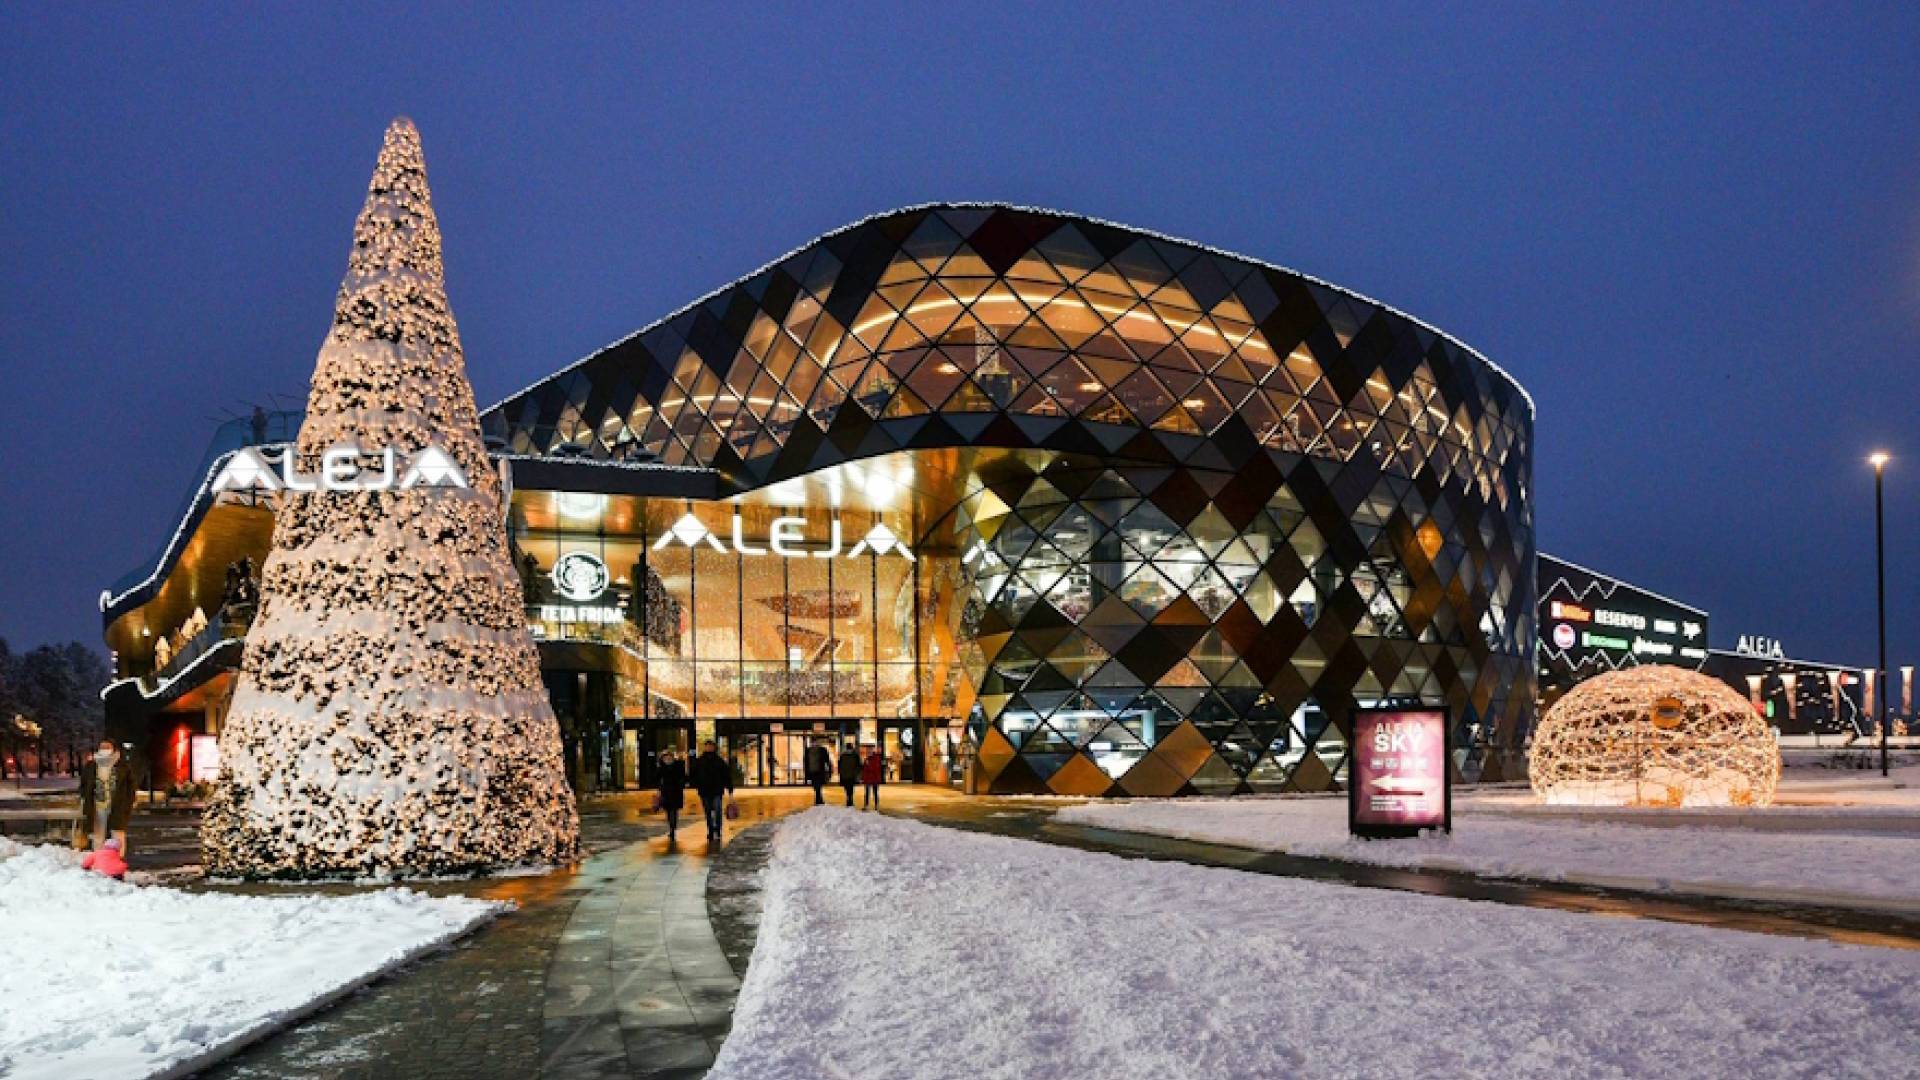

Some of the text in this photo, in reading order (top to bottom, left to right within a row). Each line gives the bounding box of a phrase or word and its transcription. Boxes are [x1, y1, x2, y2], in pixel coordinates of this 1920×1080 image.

[211, 447, 469, 490] ALEJA
[652, 513, 917, 562] ALEJA
[1737, 634, 1784, 658] ALEJA
[1374, 734, 1423, 752] SKY
